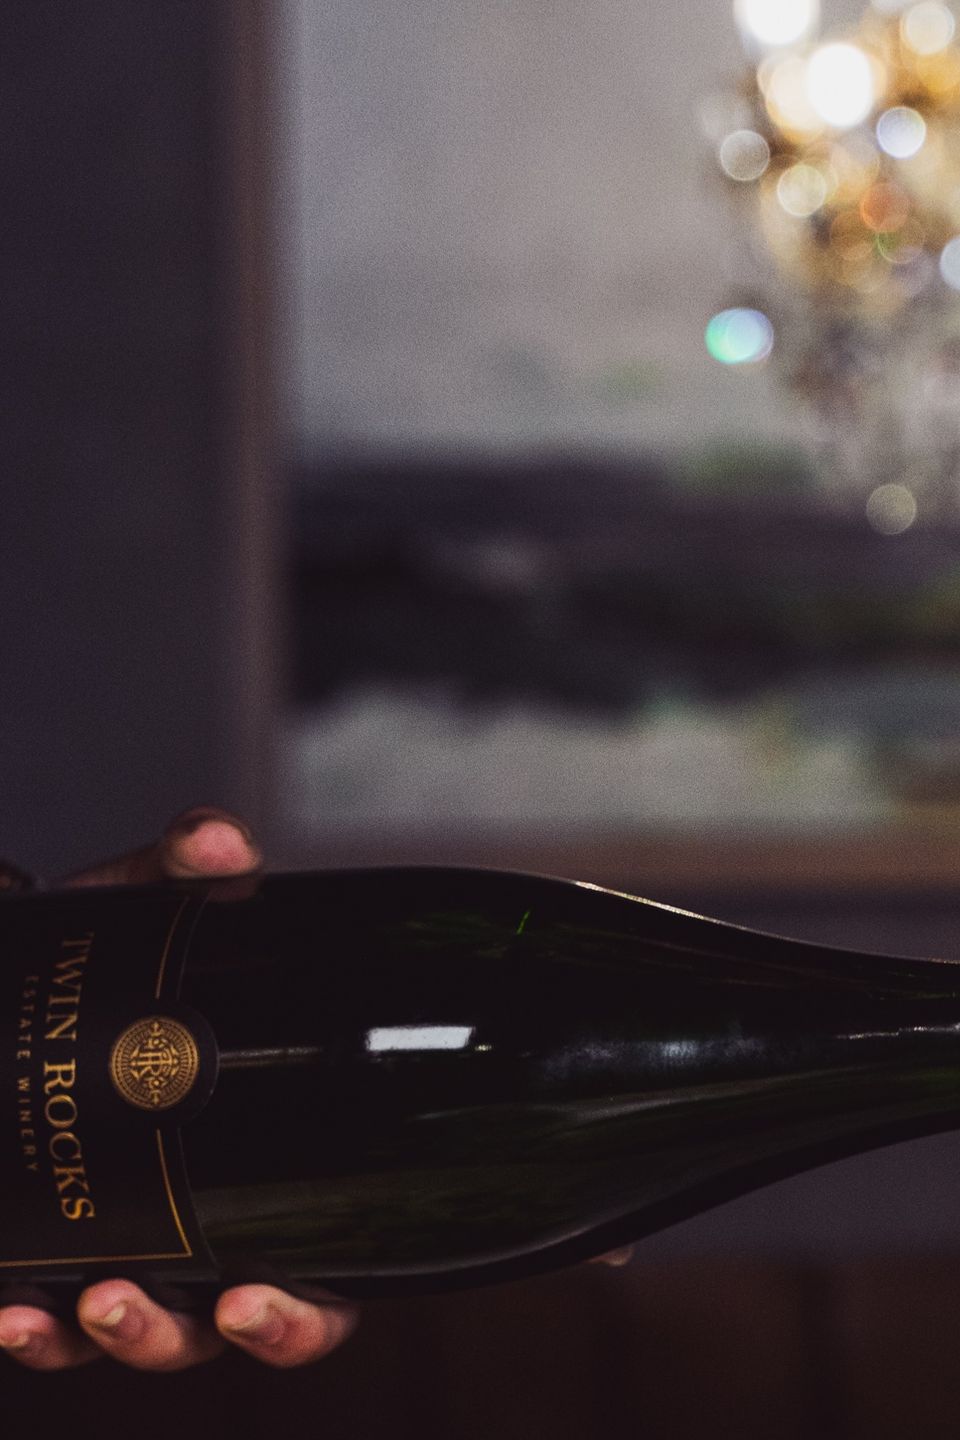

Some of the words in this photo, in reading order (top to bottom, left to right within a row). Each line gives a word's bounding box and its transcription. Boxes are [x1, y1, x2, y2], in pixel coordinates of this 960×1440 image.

[16, 975, 39, 1060] ESTATE
[43, 931, 95, 1042] TWIN
[16, 1077, 38, 1172] WINERY
[43, 1058, 96, 1220] ROCKS
